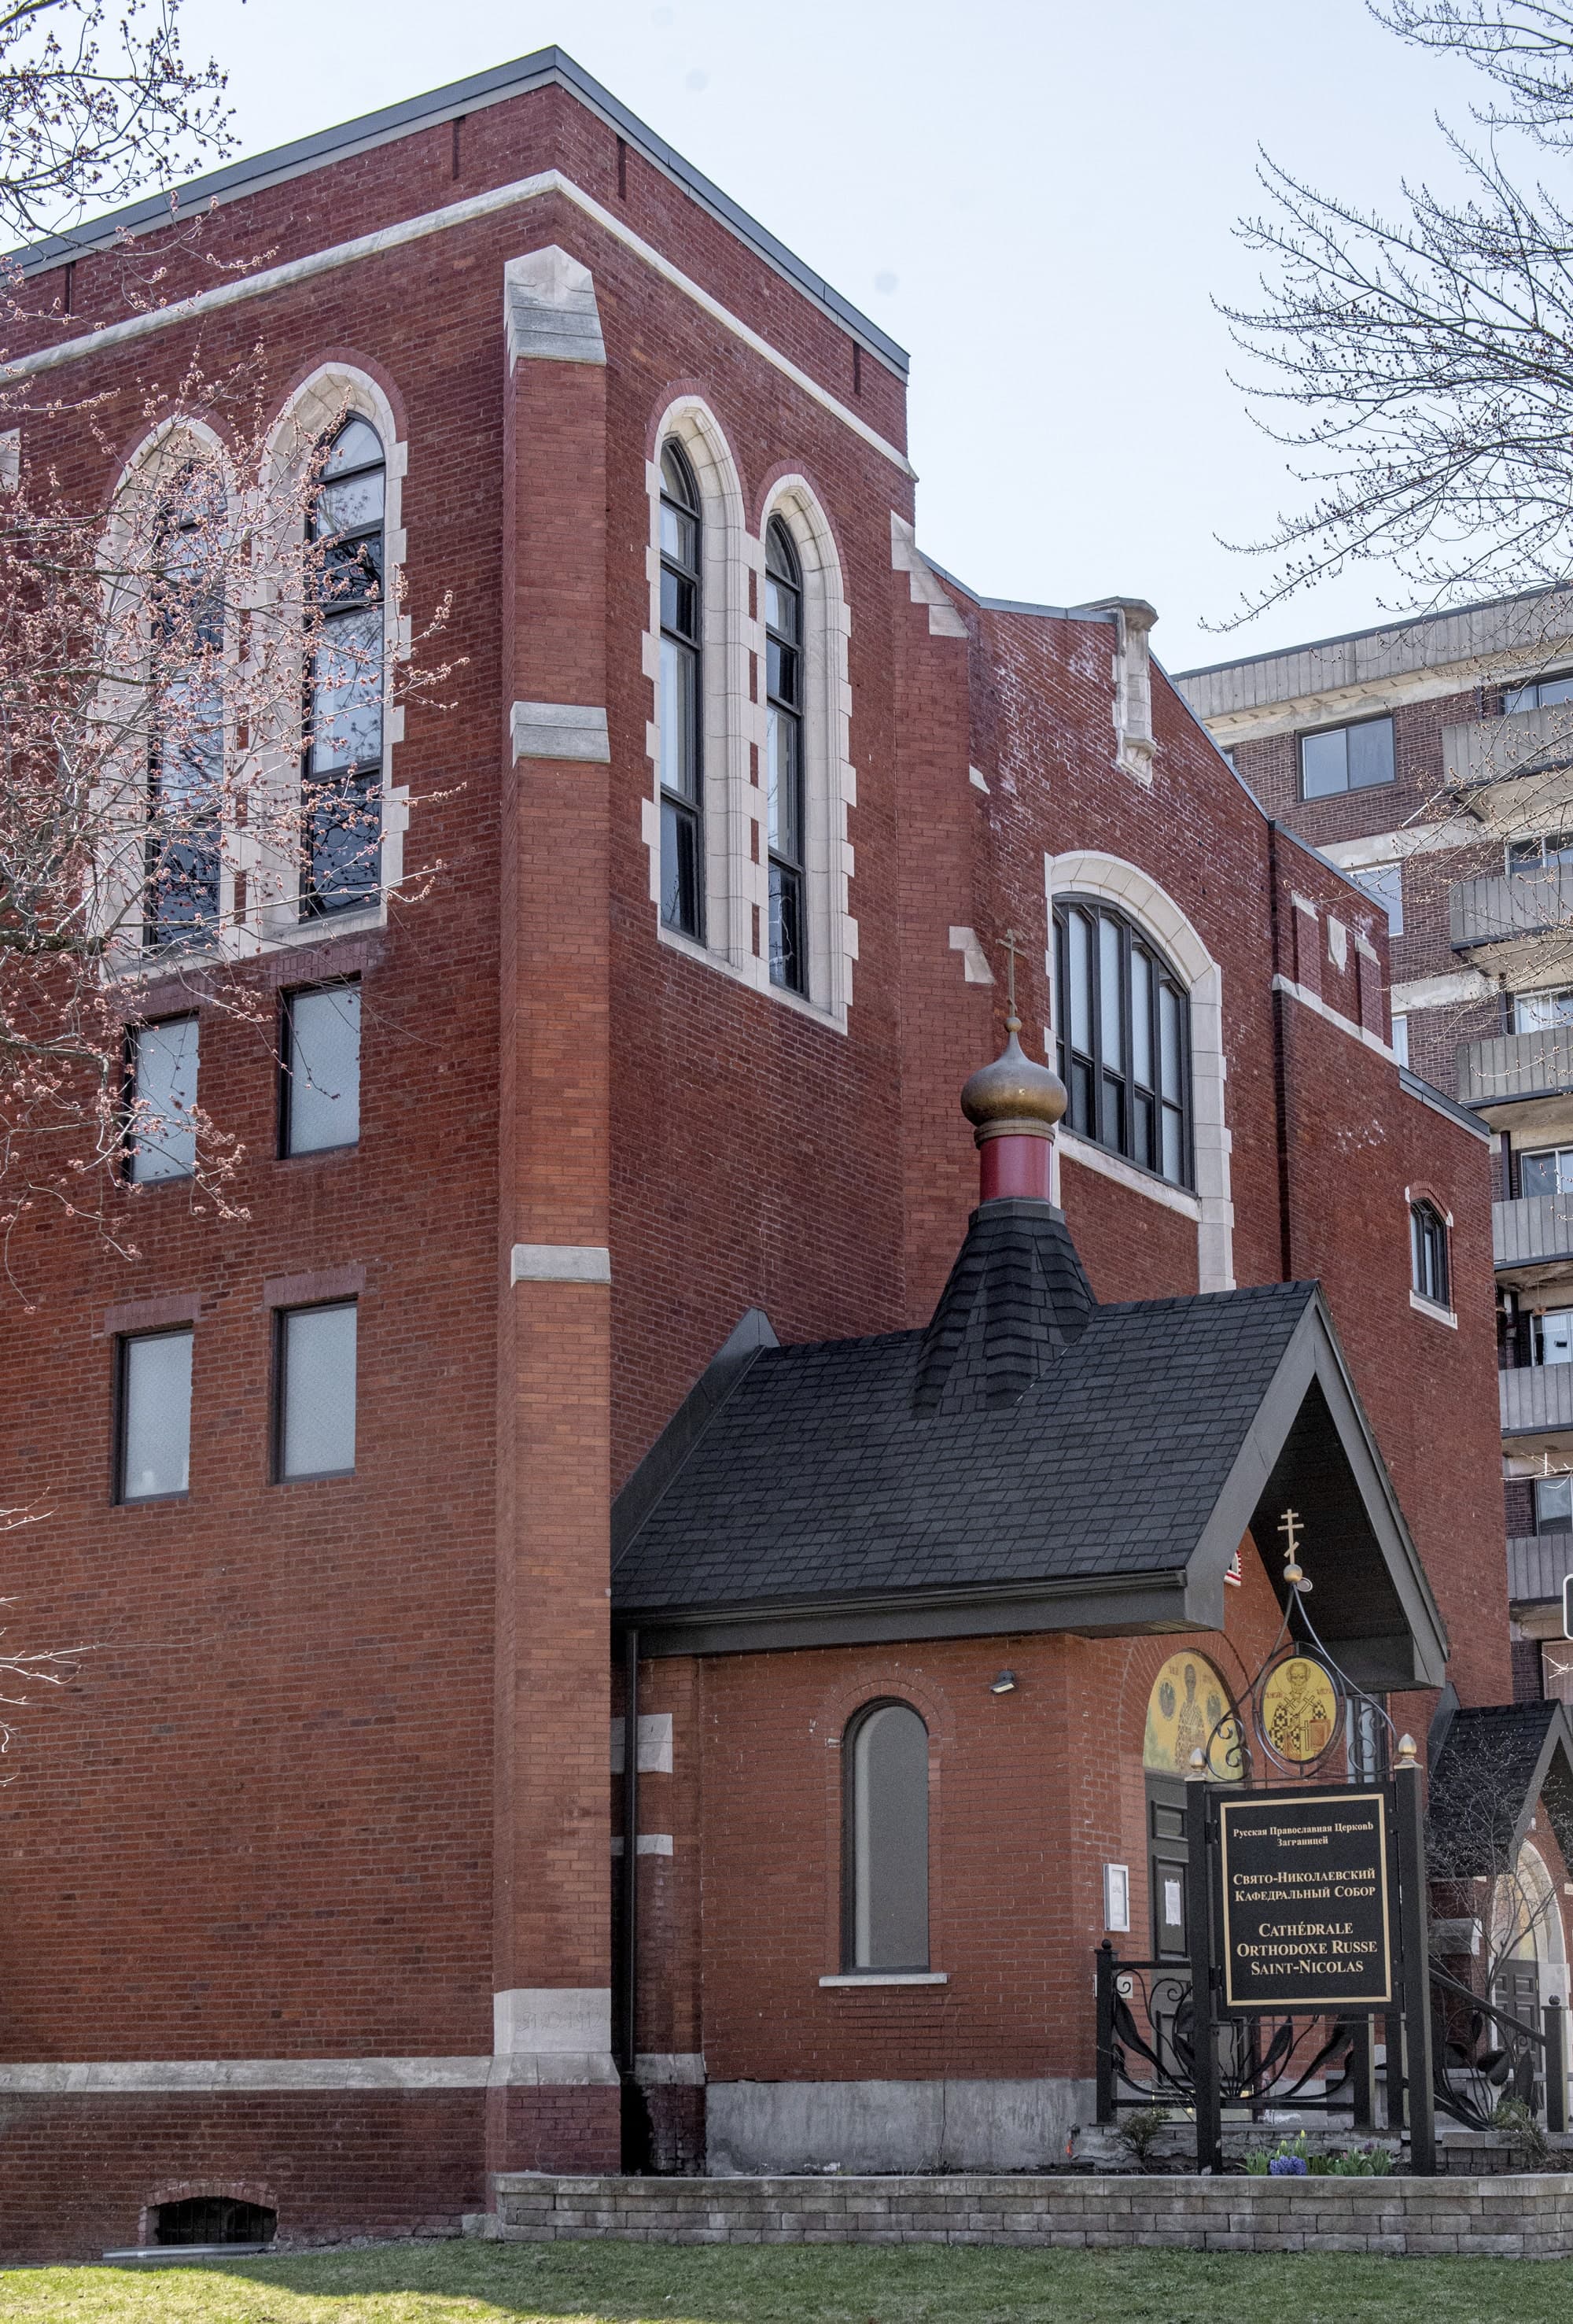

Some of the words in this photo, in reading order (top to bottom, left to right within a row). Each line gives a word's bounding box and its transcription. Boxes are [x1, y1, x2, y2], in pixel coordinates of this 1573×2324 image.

[1232, 1828, 1268, 1839] Русская
[1269, 1824, 1332, 1837] Православная
[1334, 1885, 1376, 1898] СОБОР
[1258, 1920, 1354, 1937] CATHÉDRALE
[1236, 1942, 1328, 1957] ORTHODOXE
[1331, 1939, 1378, 1954] RUSSE
[1251, 1959, 1364, 1975] SAINT-NICOLAS
